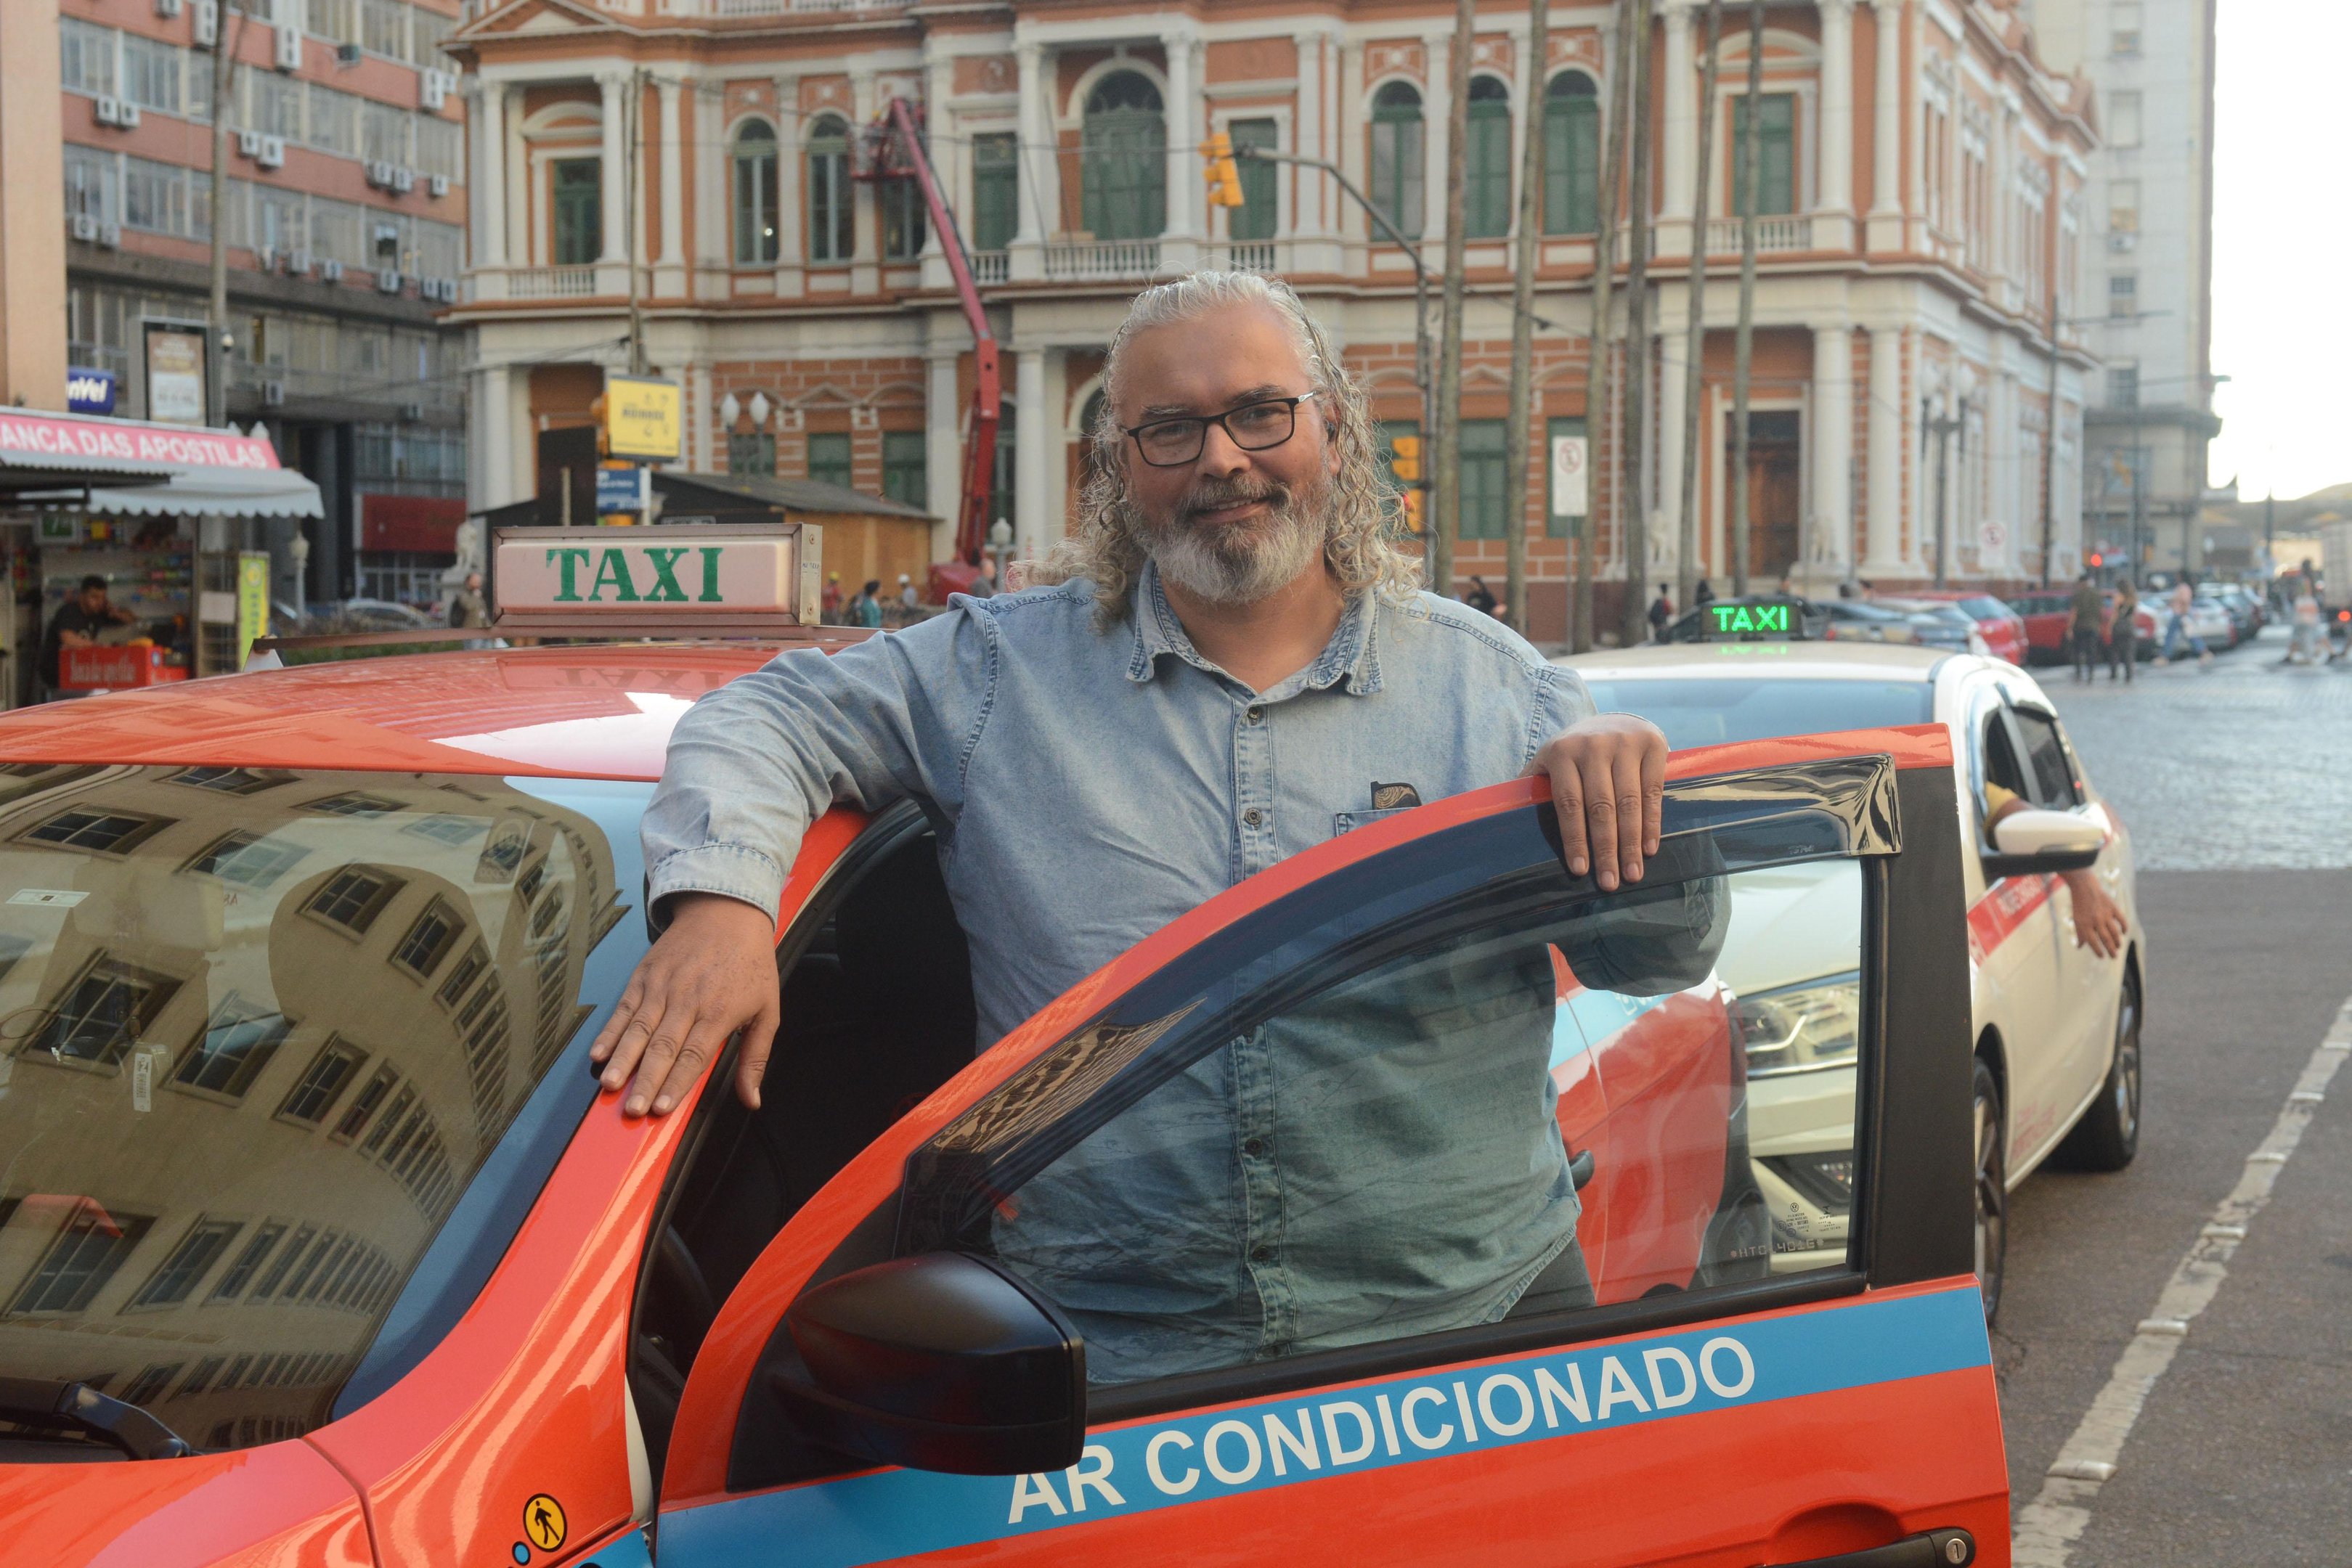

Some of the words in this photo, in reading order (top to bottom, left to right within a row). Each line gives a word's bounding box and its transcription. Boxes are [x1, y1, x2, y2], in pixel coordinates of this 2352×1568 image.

[67, 377, 108, 403] nVel
[1, 421, 77, 454] ANCA
[78, 428, 134, 459] DAS
[138, 434, 267, 469] APOSTILAS
[546, 547, 723, 603] TAXI
[1712, 605, 1788, 632] TAXI
[1008, 1445, 1126, 1524] AR
[1145, 1336, 1755, 1495] CONDICIONADO
